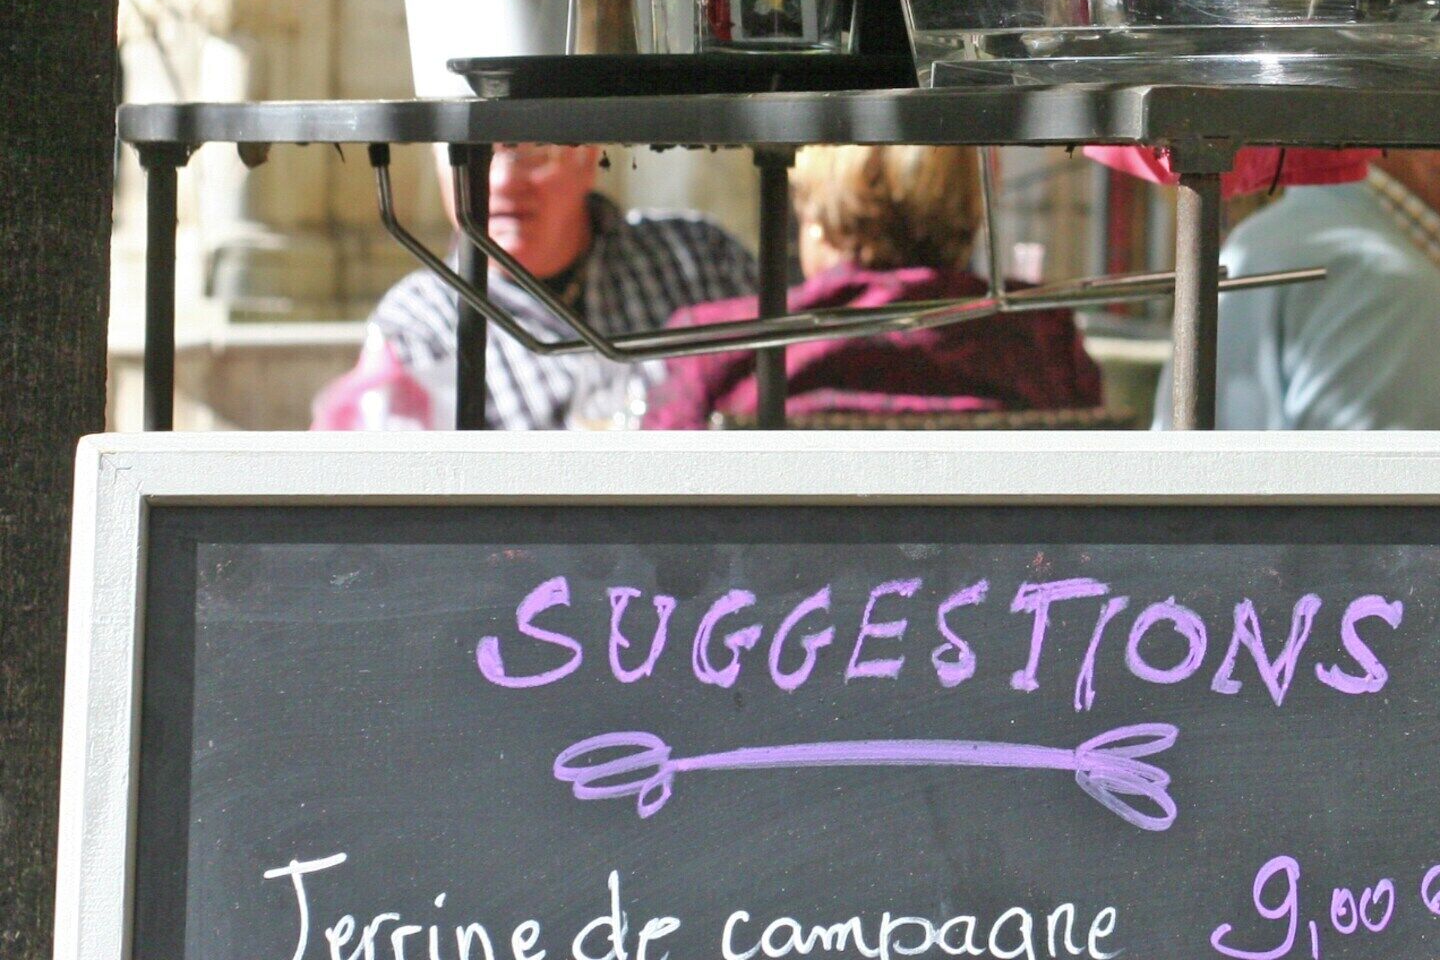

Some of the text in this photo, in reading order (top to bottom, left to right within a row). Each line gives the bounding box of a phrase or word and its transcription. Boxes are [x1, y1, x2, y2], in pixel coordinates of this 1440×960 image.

[476, 575, 1404, 711] SUGGESTIONS
[263, 852, 546, 960] Terrine
[571, 868, 681, 960] de
[721, 902, 1126, 960] campagne
[1209, 854, 1395, 960] 9,00
